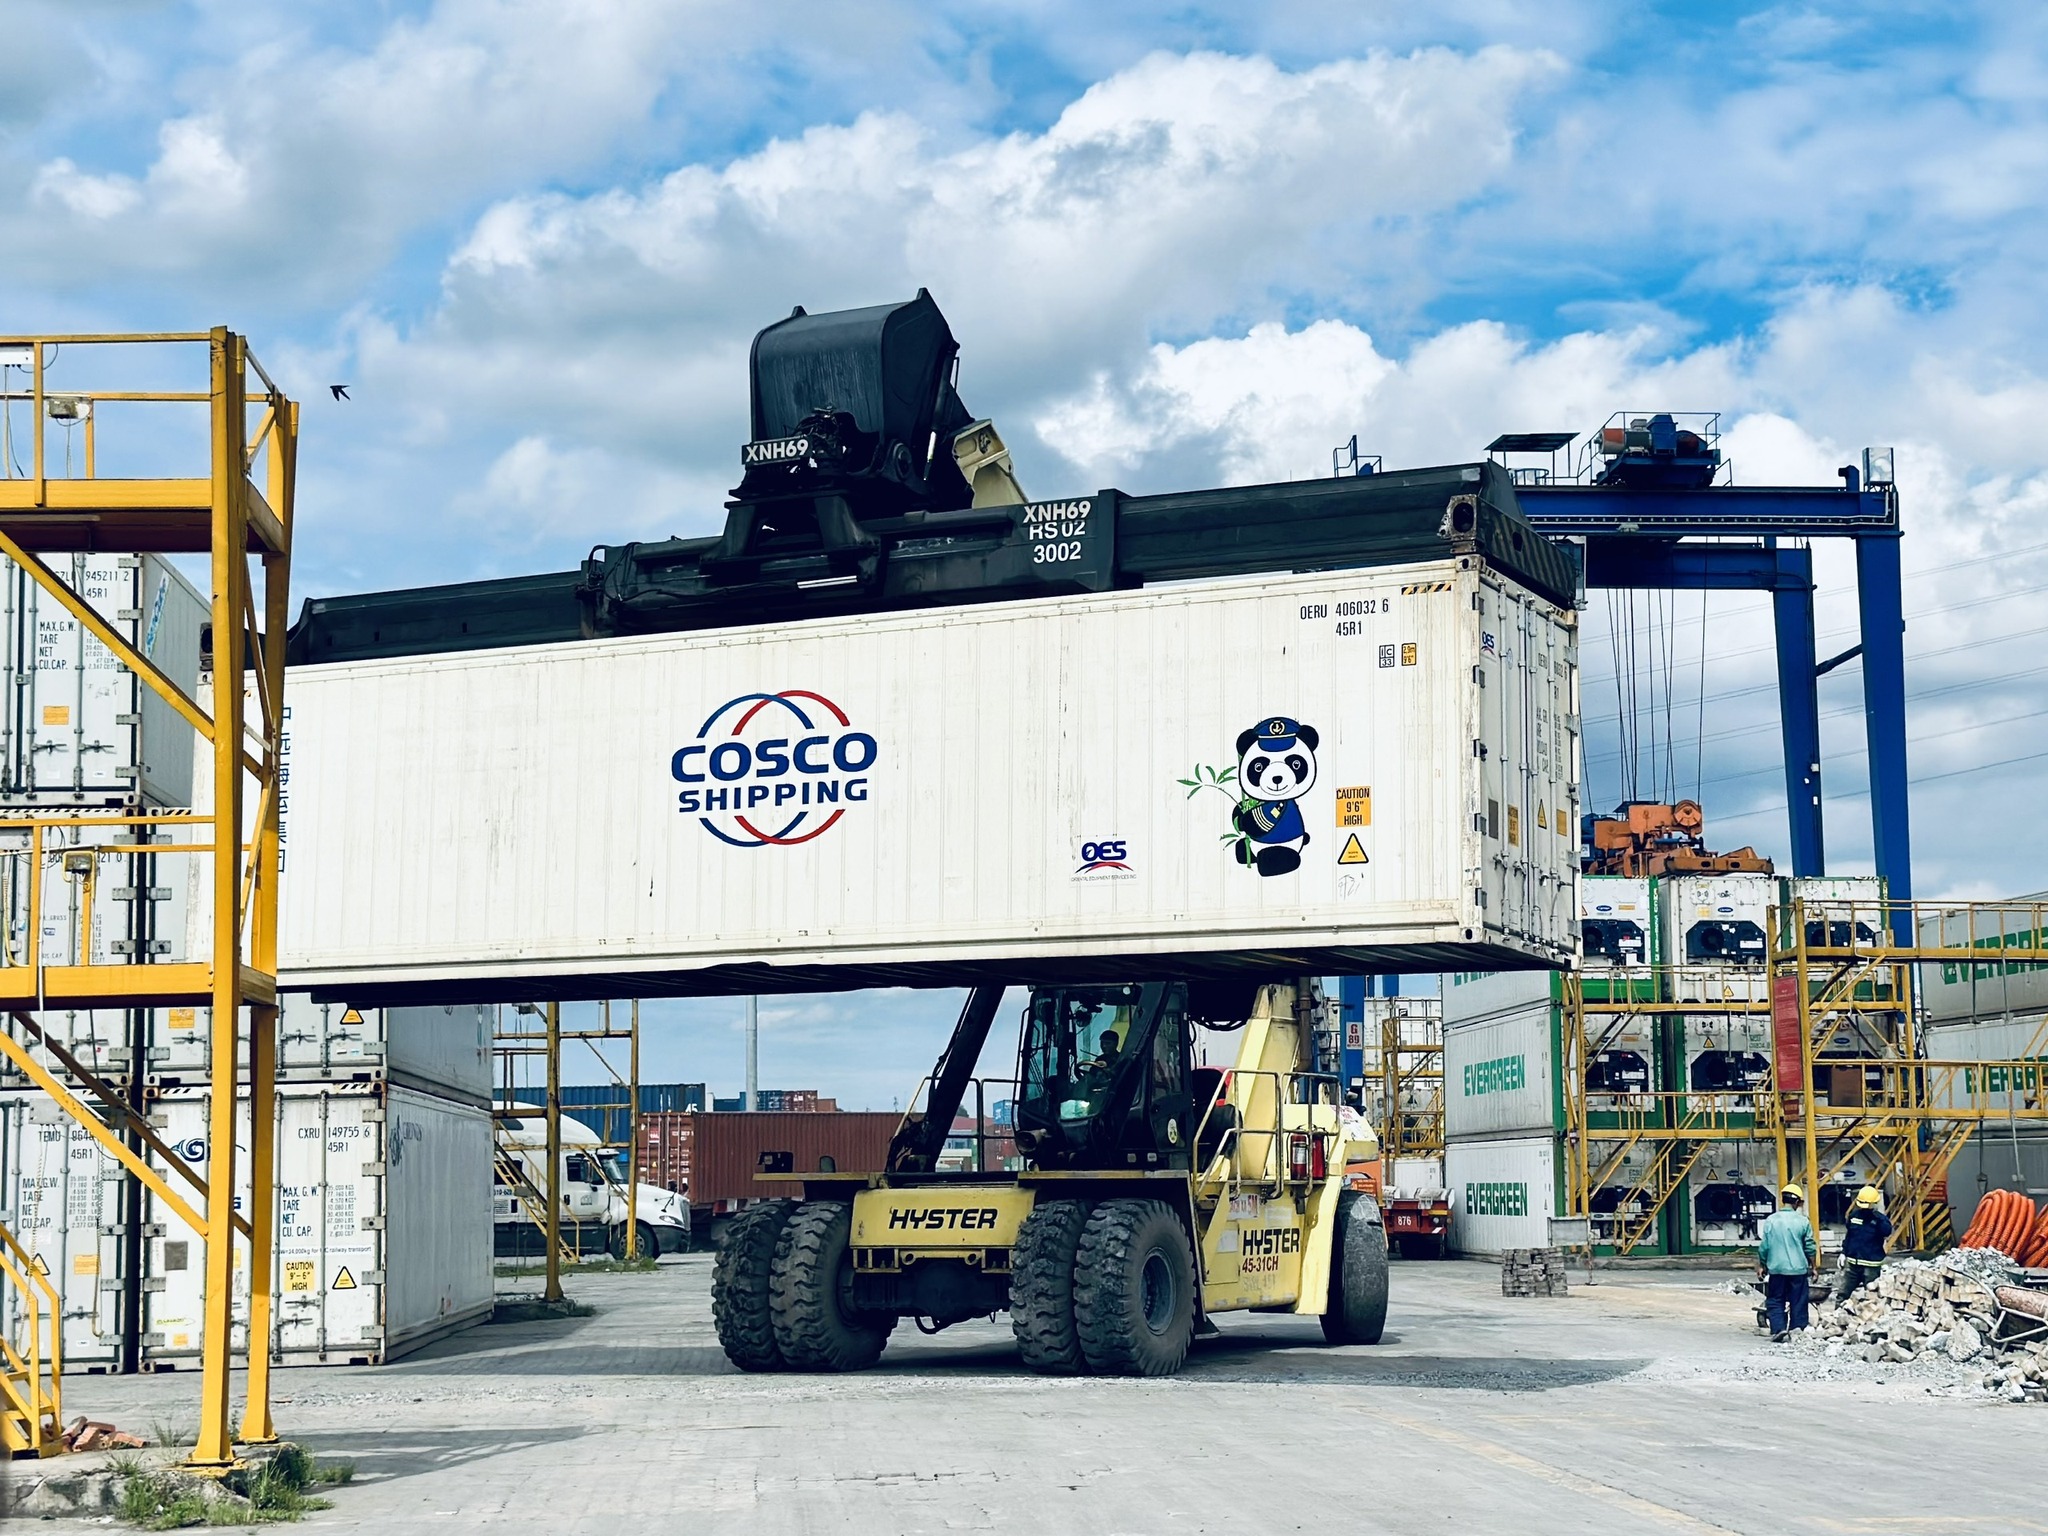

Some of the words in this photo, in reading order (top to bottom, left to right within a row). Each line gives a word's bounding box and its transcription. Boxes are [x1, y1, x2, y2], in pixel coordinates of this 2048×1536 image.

[746, 438, 808, 462] XNH69
[1024, 500, 1092, 524] XNH69
[1062, 520, 1086, 537] 02
[1033, 542, 1082, 564] 3002
[86, 571, 118, 581] 945211
[124, 571, 129, 581] 2
[86, 588, 108, 598] 45R1
[1300, 604, 1328, 620] OERU
[1336, 600, 1376, 616] 406032
[1382, 598, 1389, 612] 6
[1336, 621, 1362, 636] 45R1
[40, 634, 58, 644] TARE
[1482, 631, 1494, 648] OES
[39, 646, 52, 656] NET
[672, 732, 878, 782] COSCO
[679, 778, 868, 812] SHIPPING
[1336, 788, 1370, 800] CAUTION
[1344, 814, 1362, 826] HIGH
[1082, 840, 1126, 862] OES
[1464, 1054, 1525, 1096] EVERGREEN
[298, 1128, 320, 1138] CXRU
[328, 1126, 360, 1138] 149755
[364, 1126, 370, 1138] 6
[71, 1148, 92, 1159] 45R1
[328, 1142, 348, 1152] 45R1
[282, 1200, 300, 1210] TARE
[1466, 1182, 1528, 1216] EVERGREEN
[282, 1214, 295, 1224] NET
[888, 1208, 998, 1230] HYSTER
[1398, 1216, 1412, 1226] 876
[1242, 1228, 1300, 1256] HYSTER
[286, 1262, 314, 1270] CAUTION
[1242, 1256, 1278, 1273] 45-31CH
[292, 1282, 308, 1290] HIGH
